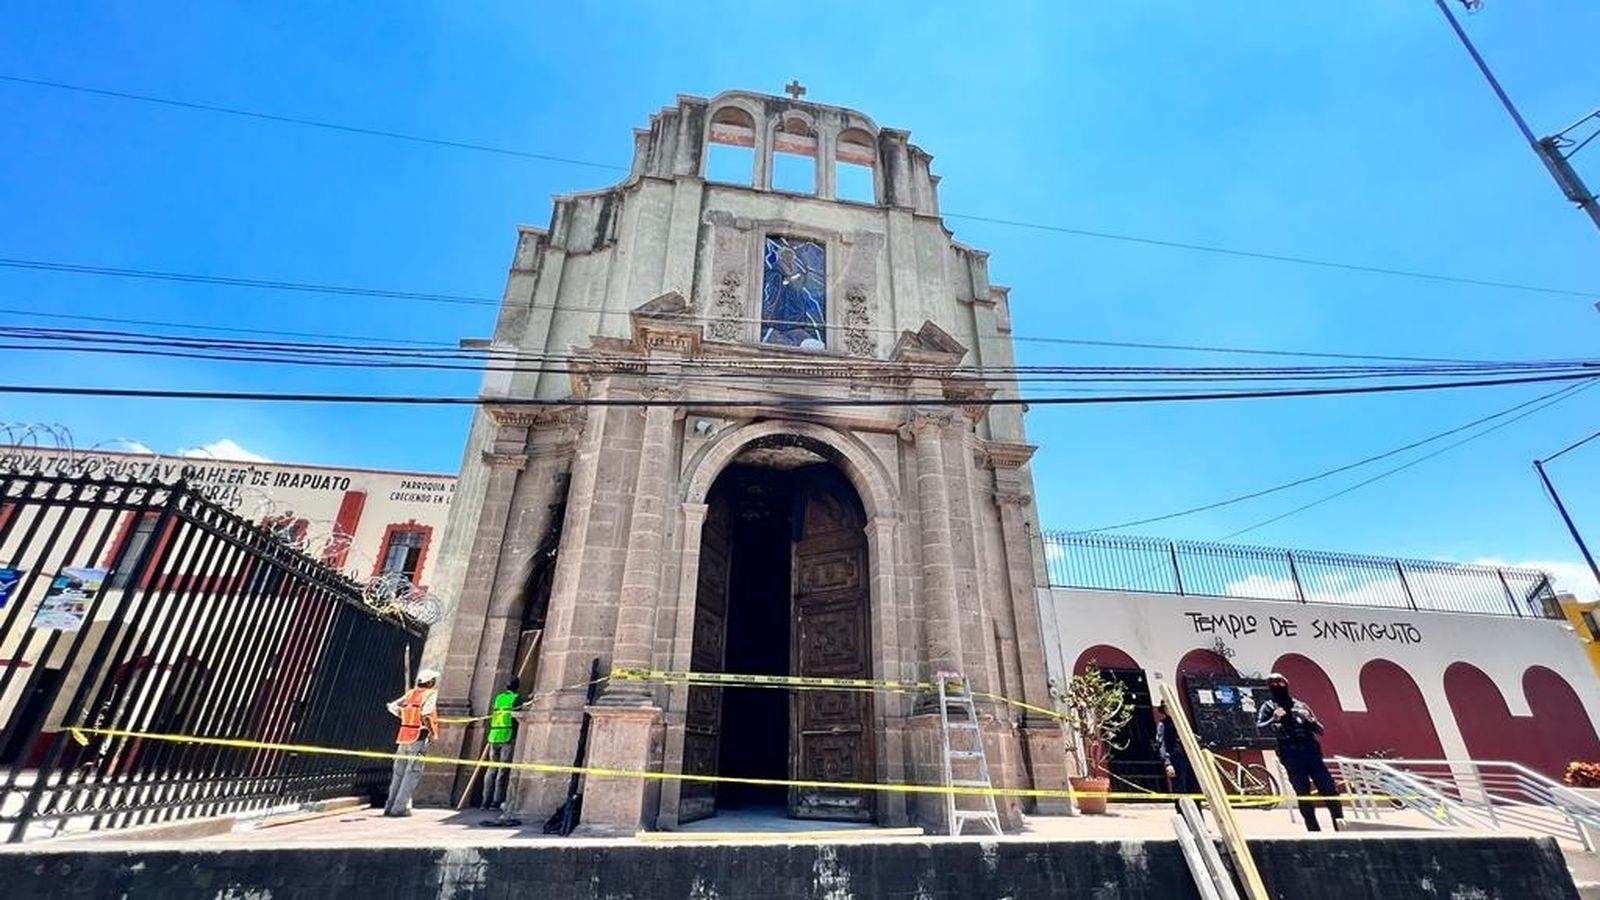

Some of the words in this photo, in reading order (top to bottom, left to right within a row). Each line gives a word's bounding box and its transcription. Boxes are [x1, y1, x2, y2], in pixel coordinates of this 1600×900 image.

[250, 469, 272, 487] DE
[273, 472, 351, 491] IRAPUATO
[400, 480, 446, 492] PARROQUIA
[389, 491, 432, 503] CRECIENDO
[433, 495, 445, 504] EN
[1184, 612, 1257, 639] TEMPLO
[1269, 616, 1298, 638] DE
[1312, 619, 1422, 645] SANTIAGUITO
